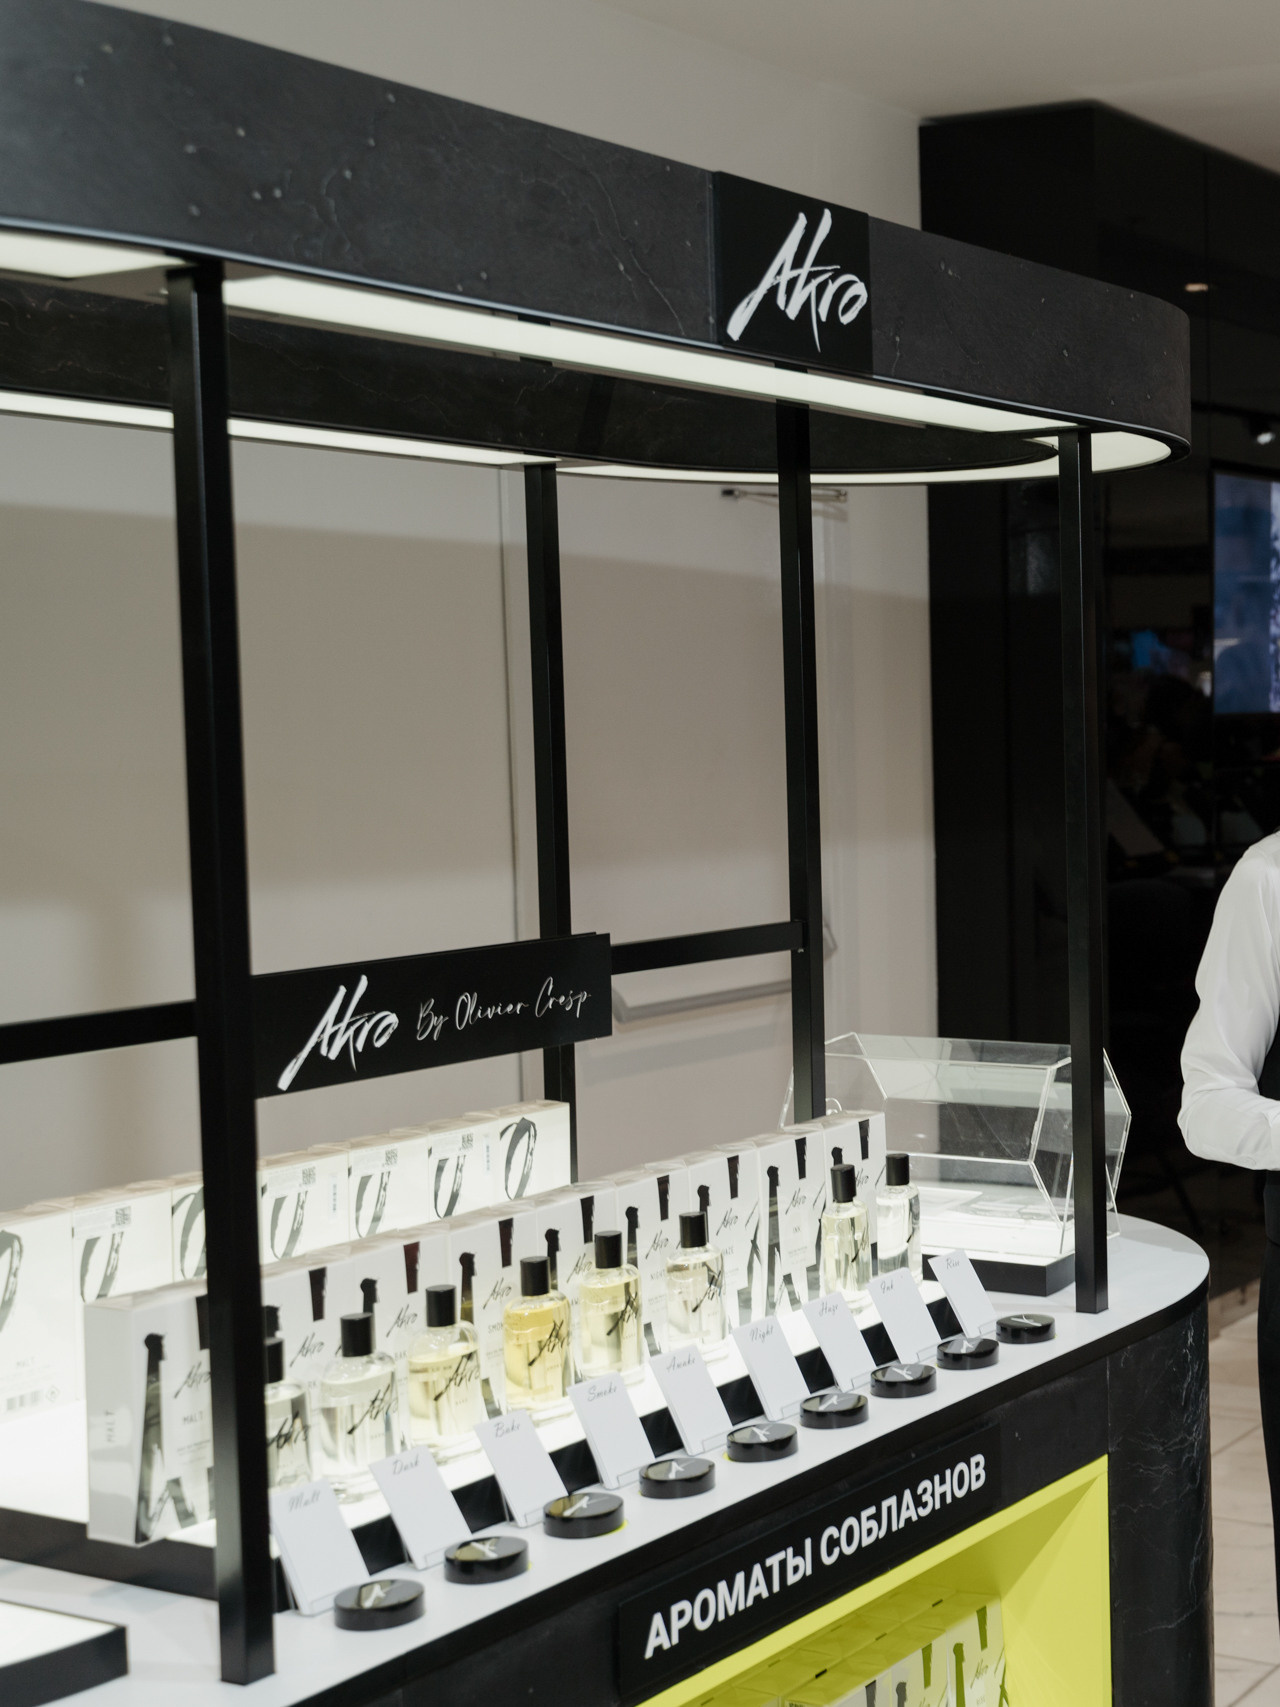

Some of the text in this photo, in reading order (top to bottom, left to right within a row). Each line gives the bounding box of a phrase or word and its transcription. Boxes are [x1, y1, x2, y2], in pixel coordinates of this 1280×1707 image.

[726, 208, 868, 352] Akro
[277, 974, 592, 1091] Akro By Olivier Cresp
[644, 1453, 986, 1660] АРОМАТЫ СОБЛАЗНОВ
